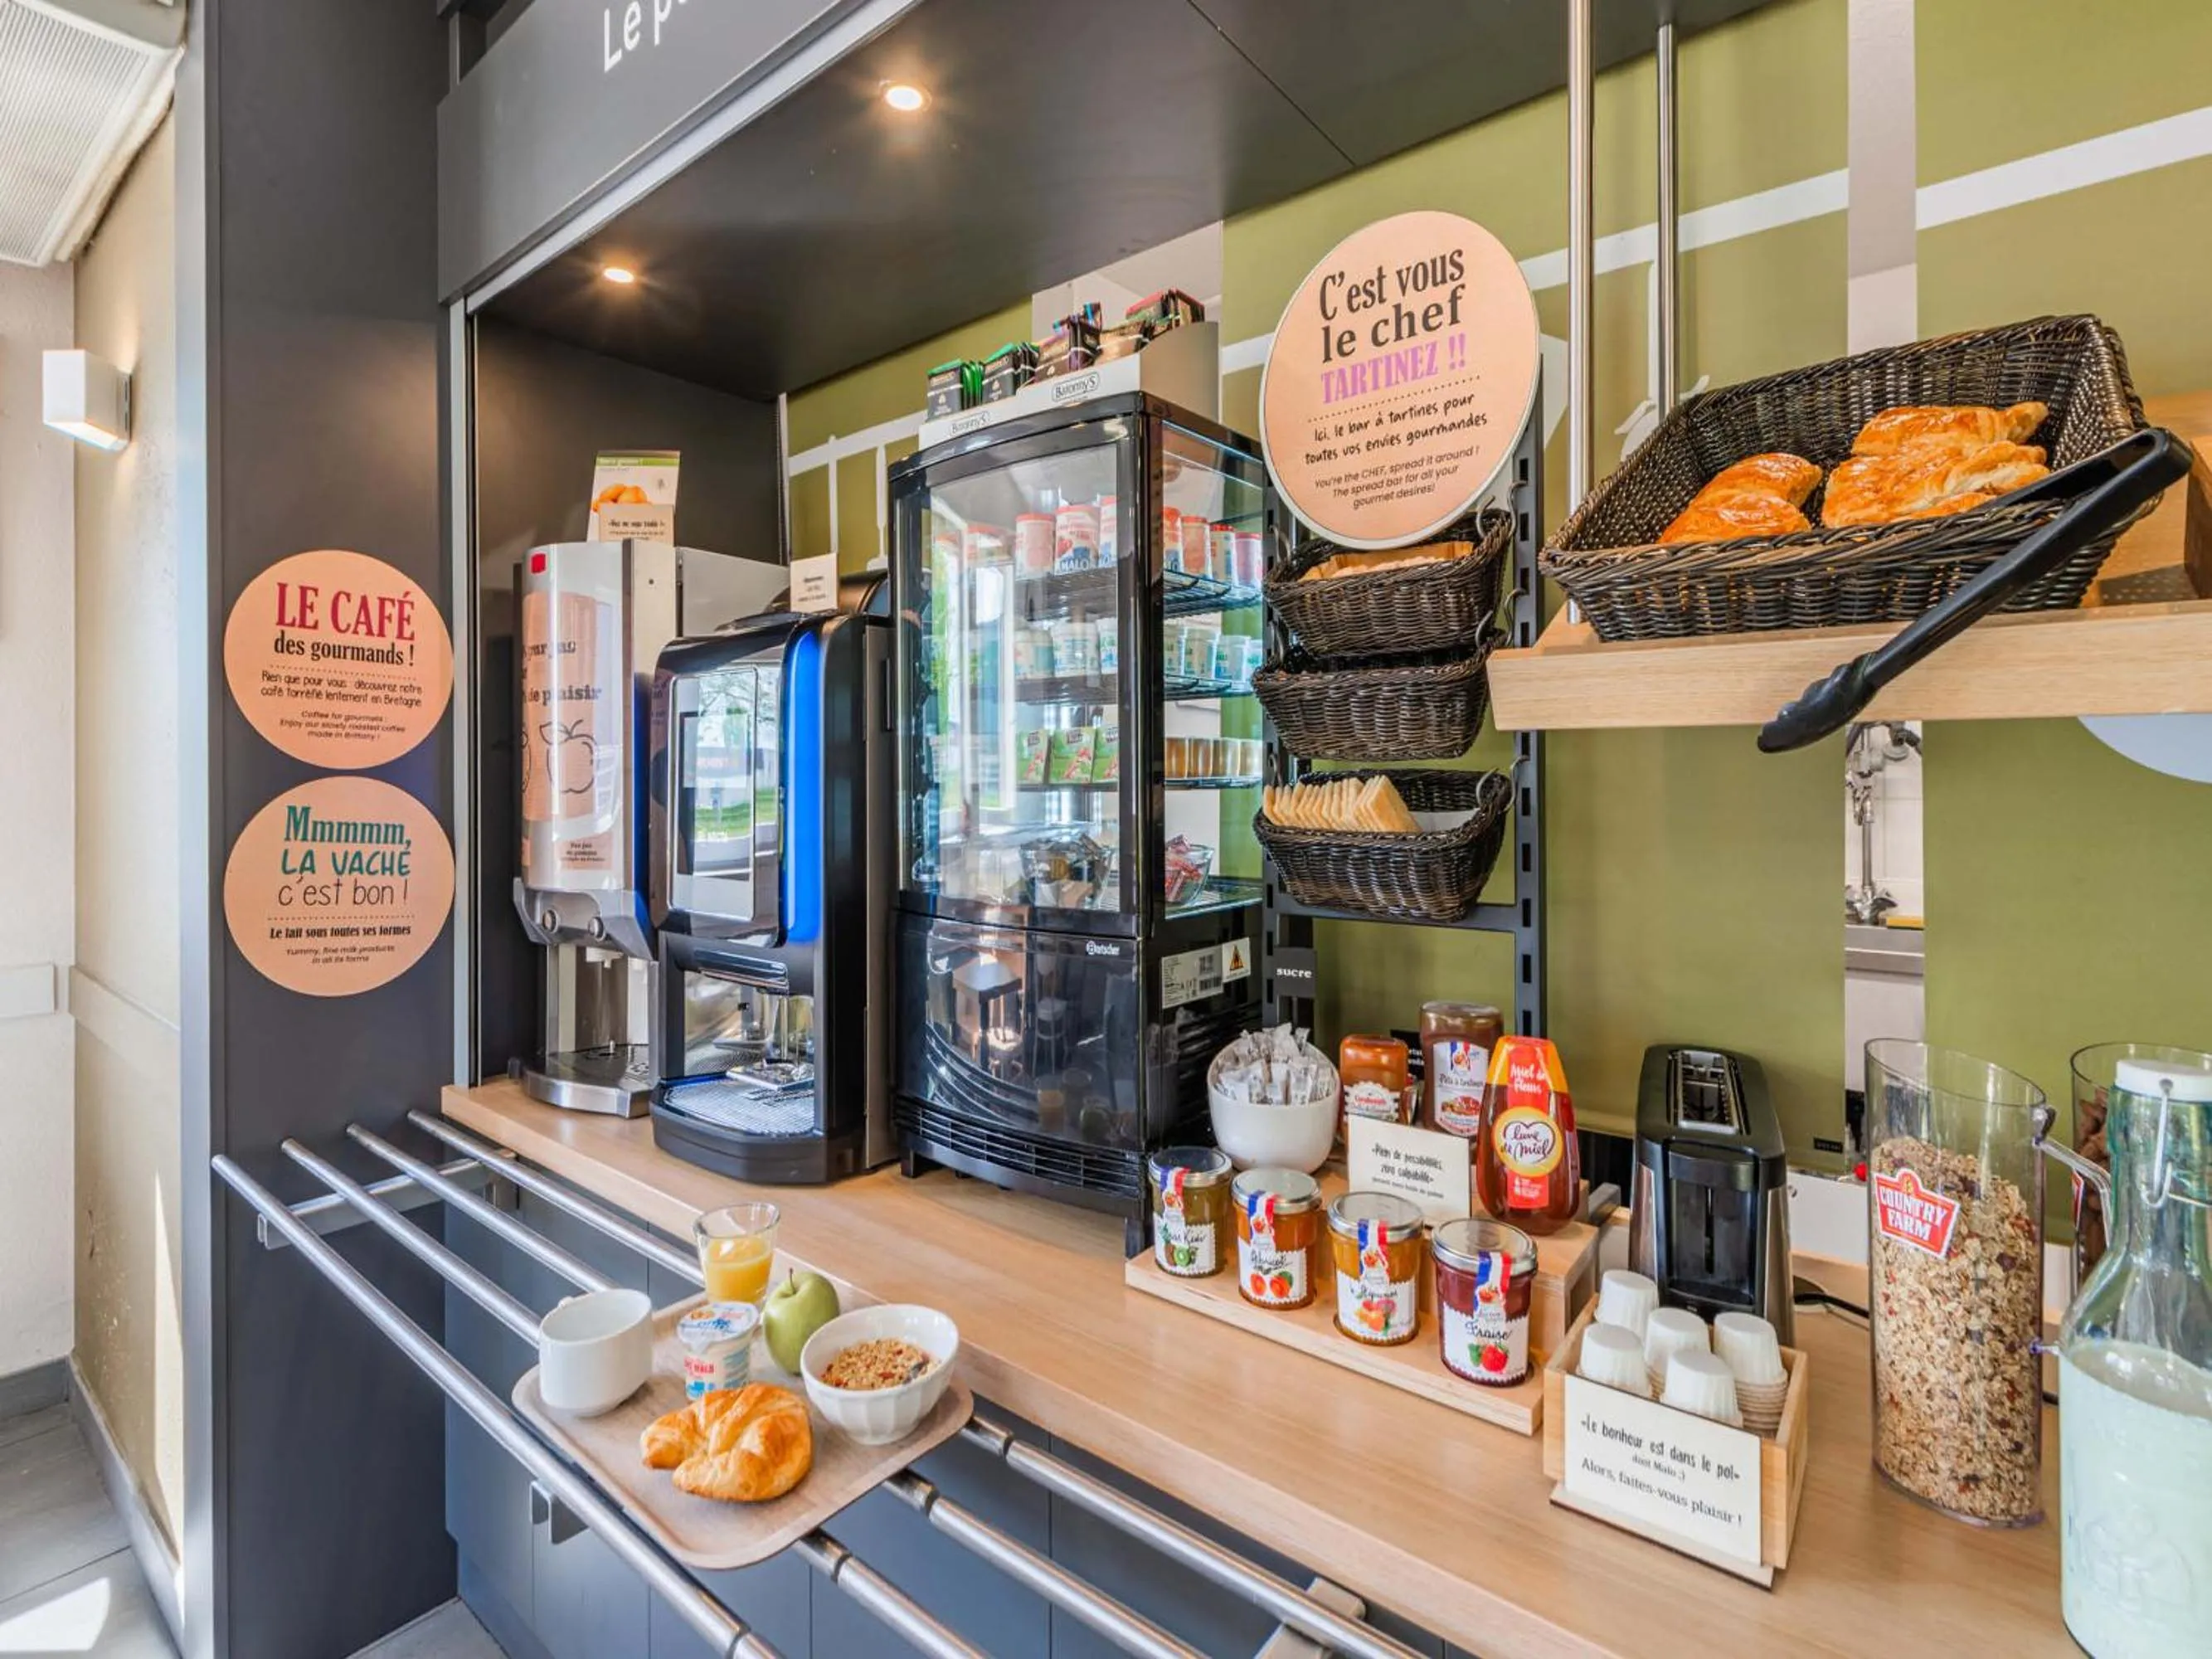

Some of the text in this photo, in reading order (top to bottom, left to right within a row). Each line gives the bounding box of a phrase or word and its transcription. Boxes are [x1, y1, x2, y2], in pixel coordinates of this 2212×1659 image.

[603, 1, 642, 74] Le
[1319, 248, 1466, 322] C'est vous
[1321, 283, 1466, 363] le chef
[1320, 341, 1439, 405] TARTINEZ
[1334, 424, 1344, 438] le
[1349, 419, 1370, 434] bar
[1389, 401, 1439, 425] tartines
[1443, 394, 1475, 417] pour
[1305, 412, 1488, 465] toutes vos envies gourmandes
[1332, 465, 1460, 498] The spread bar for all your
[1344, 471, 1359, 484] the
[1389, 457, 1424, 474] spread
[1426, 455, 1433, 466] it
[1435, 446, 1474, 463] around
[1353, 491, 1394, 510] gourmet
[275, 581, 416, 641] LE CAFÉ
[274, 629, 305, 656] des
[311, 641, 405, 665] gourmands
[260, 685, 284, 697] café
[326, 690, 368, 704] lentement
[372, 695, 382, 704] en
[384, 694, 422, 708] Bretagne
[261, 670, 283, 684] Rien
[284, 674, 300, 688] que
[304, 675, 323, 689] pour
[400, 684, 423, 695] notre
[284, 805, 412, 851] Mmmmm,
[280, 849, 411, 877] LA VACHE
[278, 876, 343, 907] c'est
[352, 878, 395, 906] bon
[270, 925, 412, 940] Le lait sous toutes ses formes
[1276, 966, 1313, 979] sucre
[1878, 1185, 1948, 1228] COUNTRY
[1887, 1209, 1932, 1243] FARM
[1466, 1321, 1513, 1341] Fraise
[1602, 1421, 1643, 1449] bonheur
[1649, 1439, 1665, 1456] est
[1670, 1445, 1696, 1469] dans
[1701, 1454, 1712, 1473] le
[1690, 1498, 1736, 1525] plaisir
